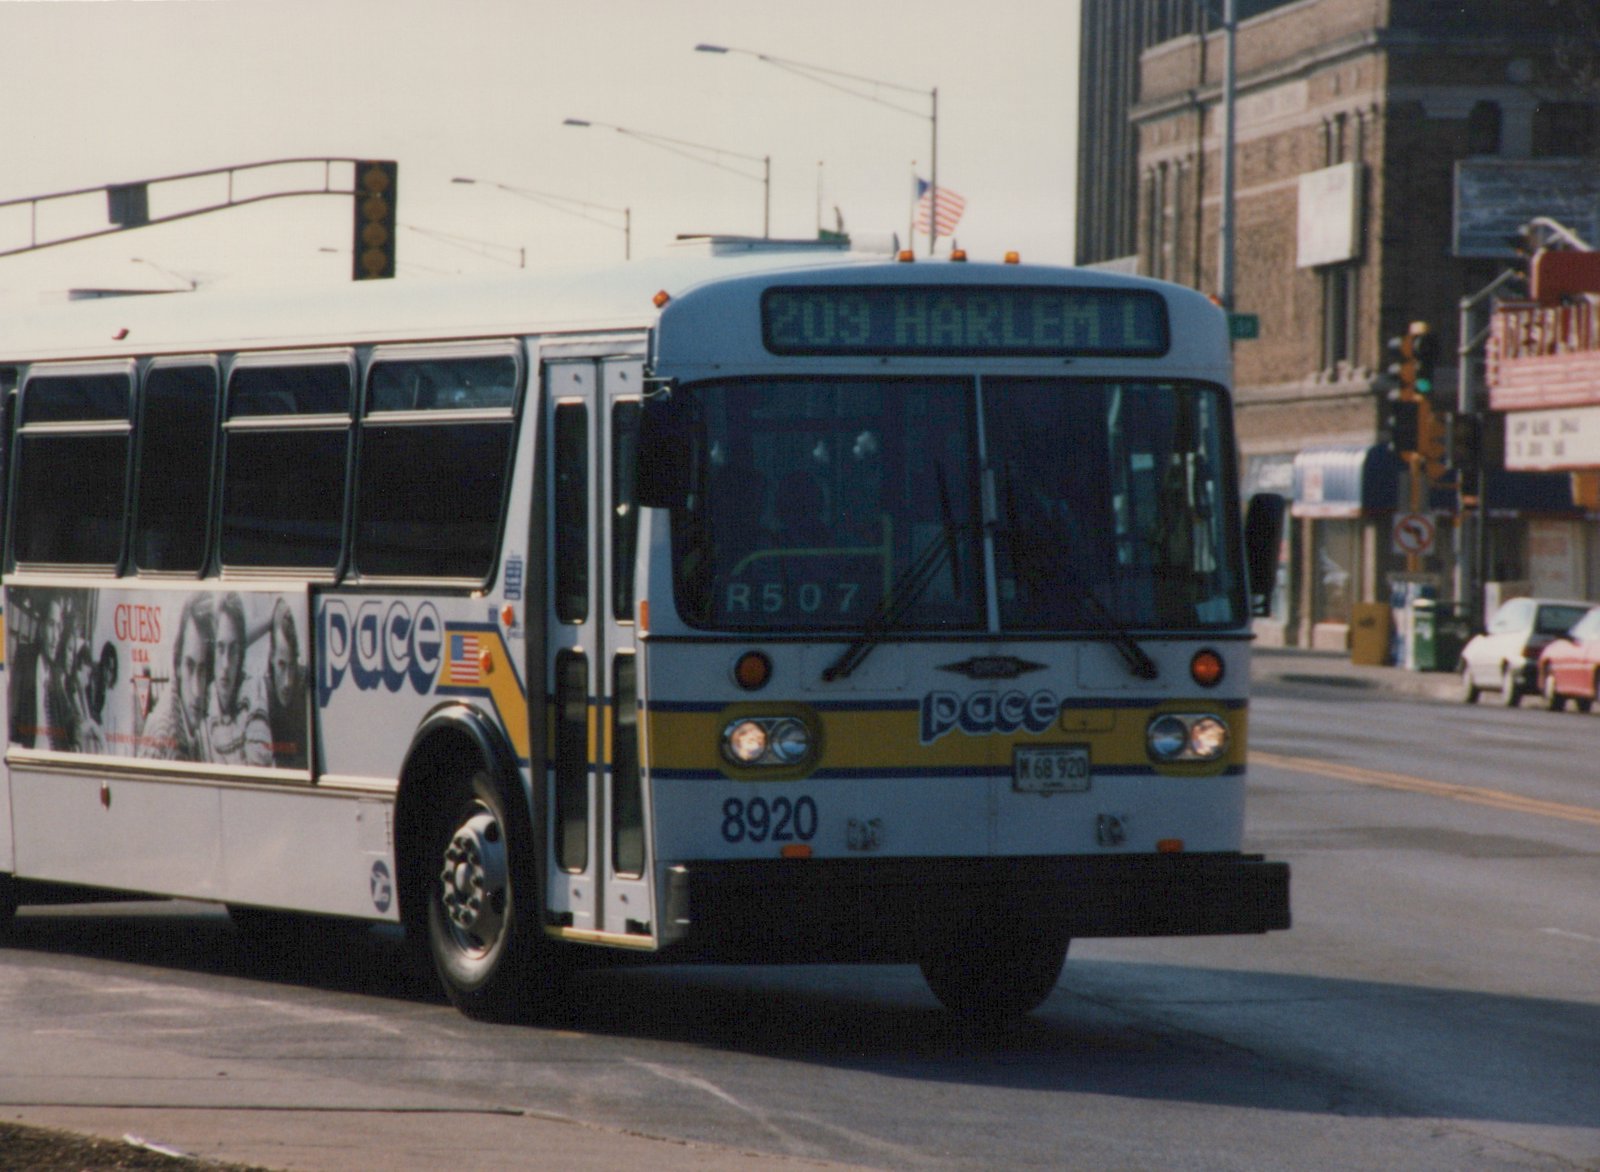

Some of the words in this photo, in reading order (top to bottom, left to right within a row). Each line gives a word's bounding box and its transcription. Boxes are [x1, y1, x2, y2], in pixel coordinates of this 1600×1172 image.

[895, 294, 1099, 346] HARLEM
[1121, 298, 1152, 347] L
[114, 603, 161, 643] GUESS
[317, 598, 442, 708] pace
[919, 689, 1060, 744] pace
[721, 794, 818, 844] 8920
